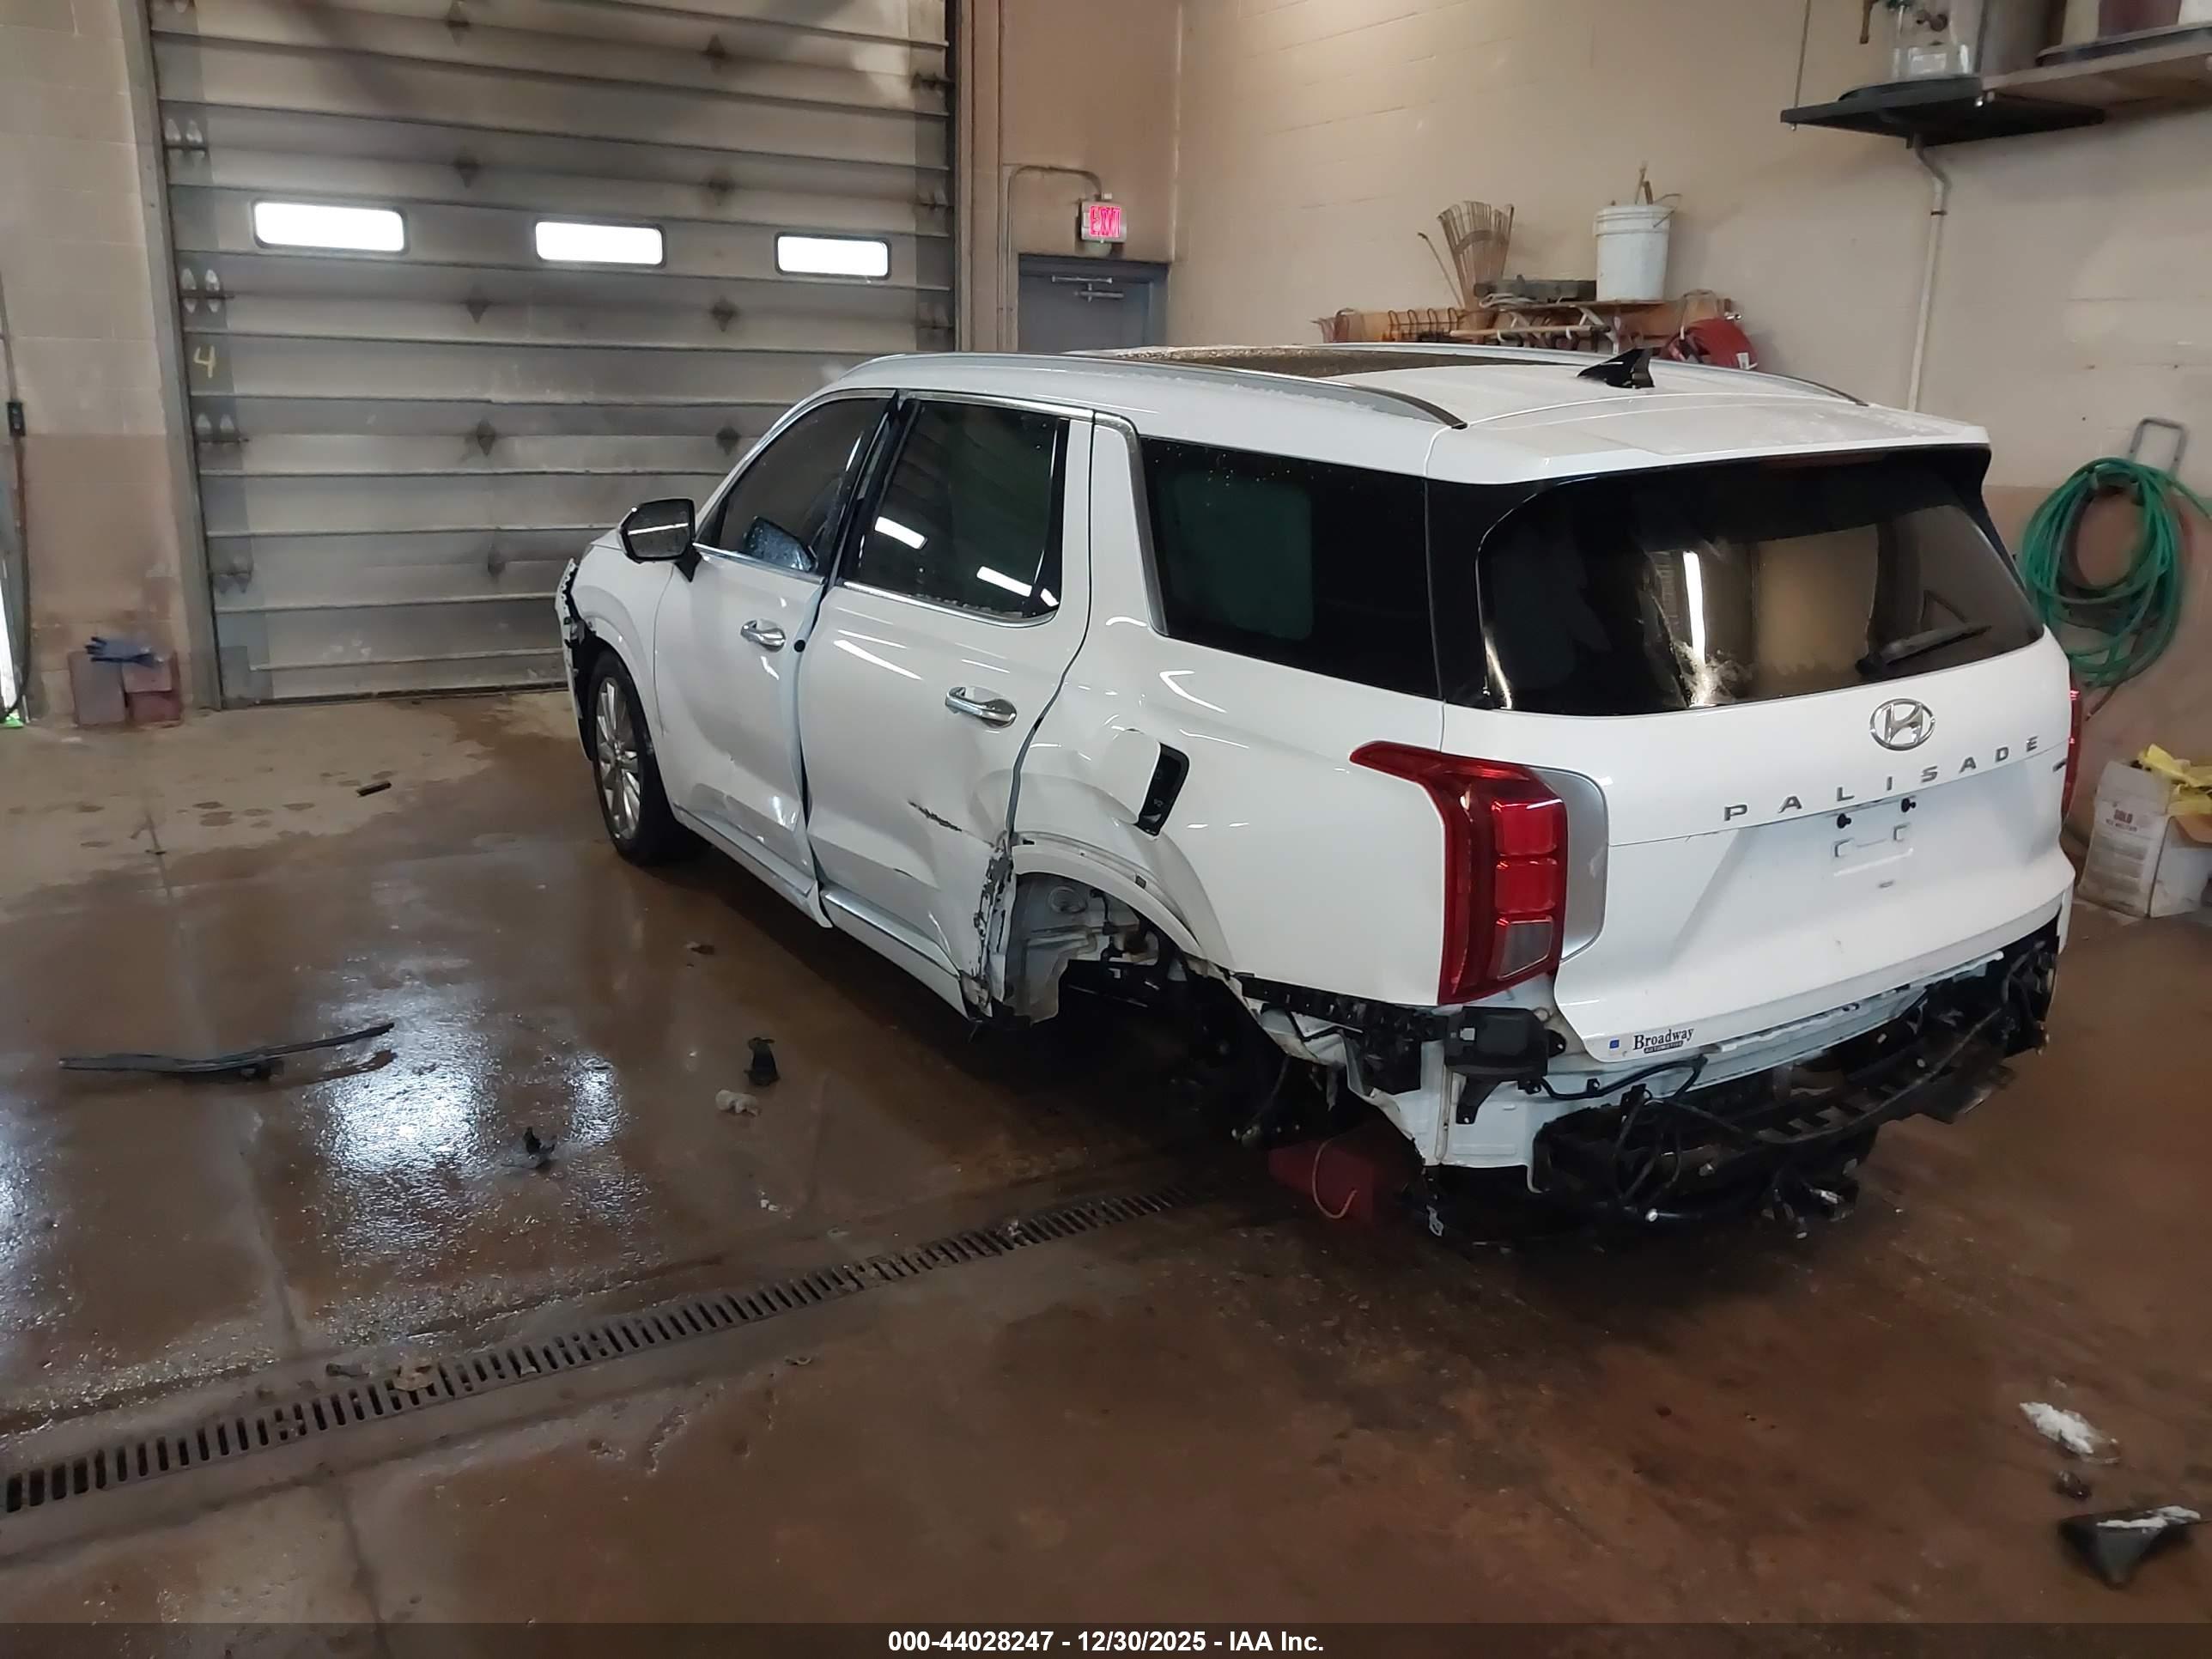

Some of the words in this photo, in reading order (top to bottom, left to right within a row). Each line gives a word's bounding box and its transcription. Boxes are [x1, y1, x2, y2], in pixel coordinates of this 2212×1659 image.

[1090, 206, 1121, 237] EXIT
[193, 345, 216, 378] 4
[1724, 736, 2039, 821] PALISADE
[1633, 1029, 1694, 1050] Broadway
